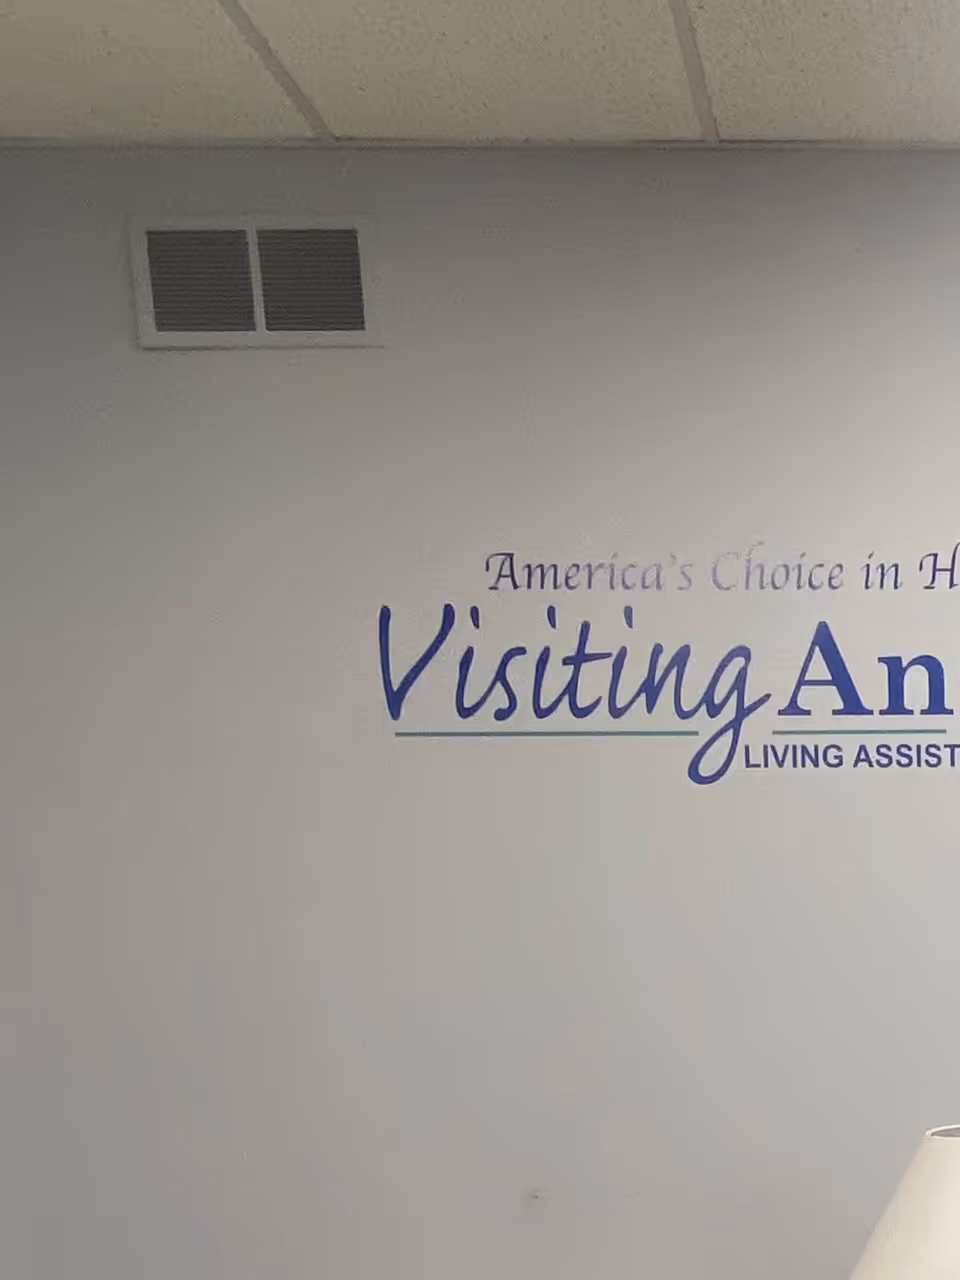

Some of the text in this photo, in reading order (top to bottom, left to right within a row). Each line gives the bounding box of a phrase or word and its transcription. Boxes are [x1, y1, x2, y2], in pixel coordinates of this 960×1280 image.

[485, 552, 694, 591] America's
[711, 540, 844, 591] Choice
[862, 551, 903, 590] in
[378, 602, 772, 785] Visiting
[744, 743, 844, 769] LIVING
